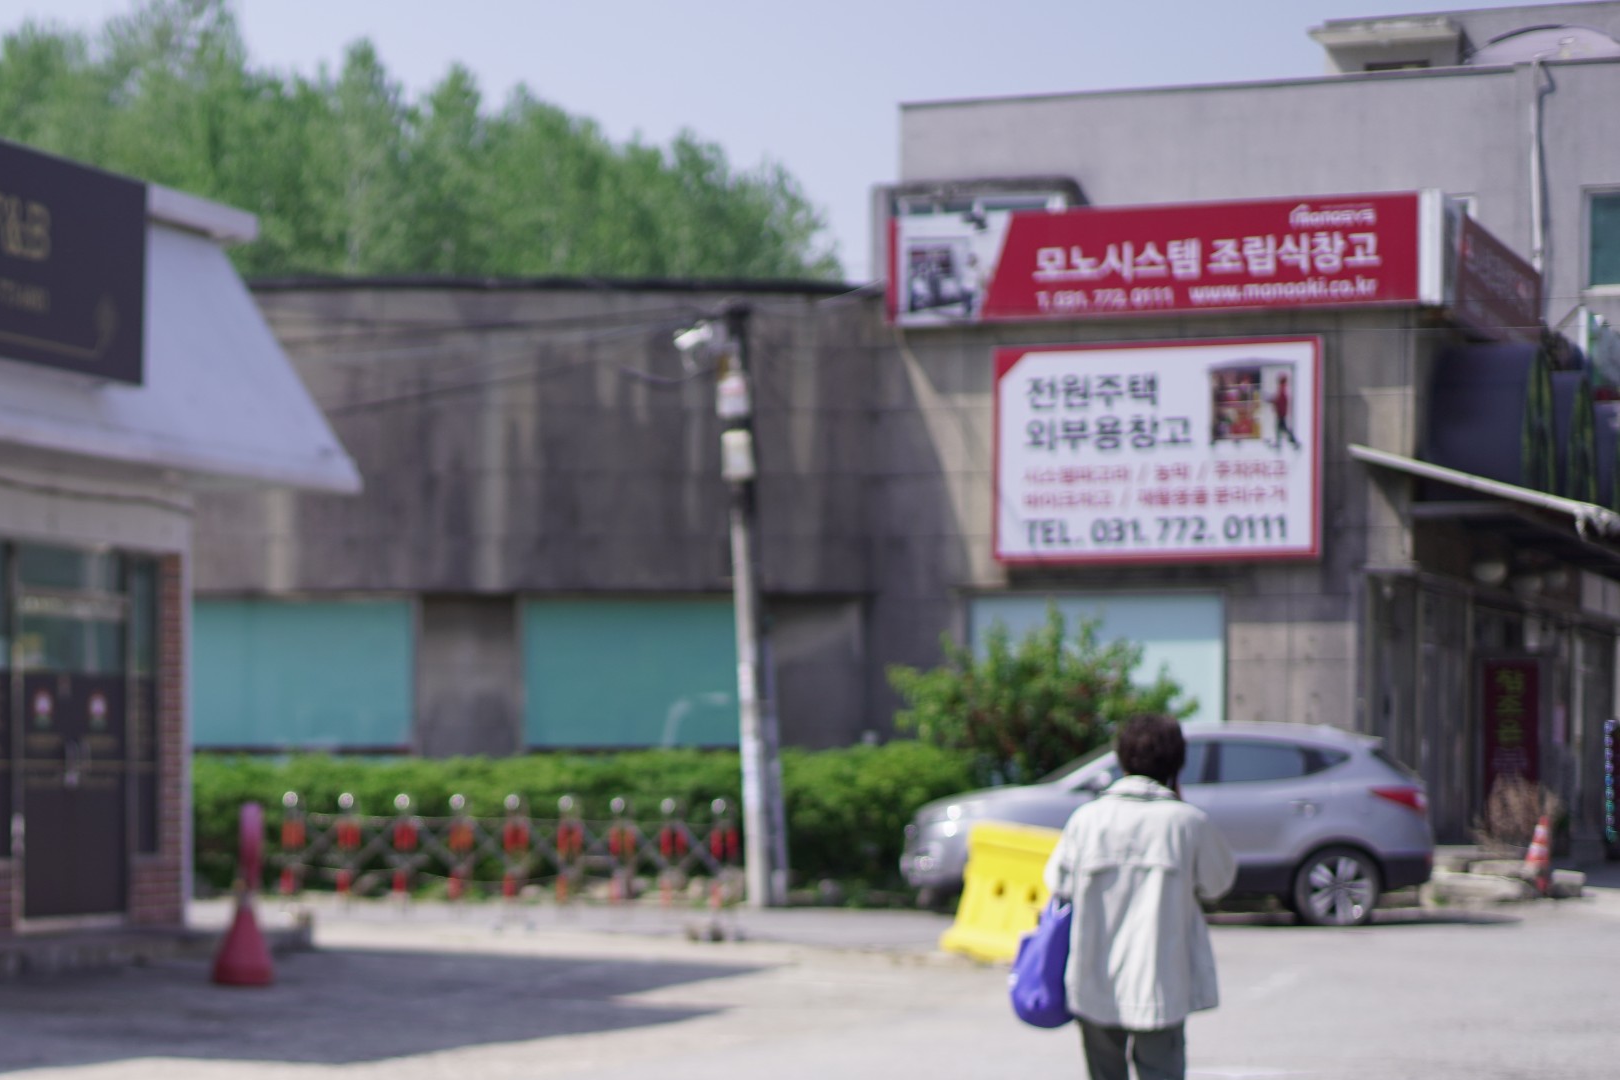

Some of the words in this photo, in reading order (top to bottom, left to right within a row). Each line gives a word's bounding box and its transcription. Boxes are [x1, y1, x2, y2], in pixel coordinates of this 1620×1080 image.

[1032, 237, 1201, 282] 모노시스템
[1207, 231, 1382, 275] 조립식창고
[1026, 374, 1159, 409] 전원주택
[1026, 414, 1192, 450] 외부용창고
[1222, 514, 1289, 541] 0111
